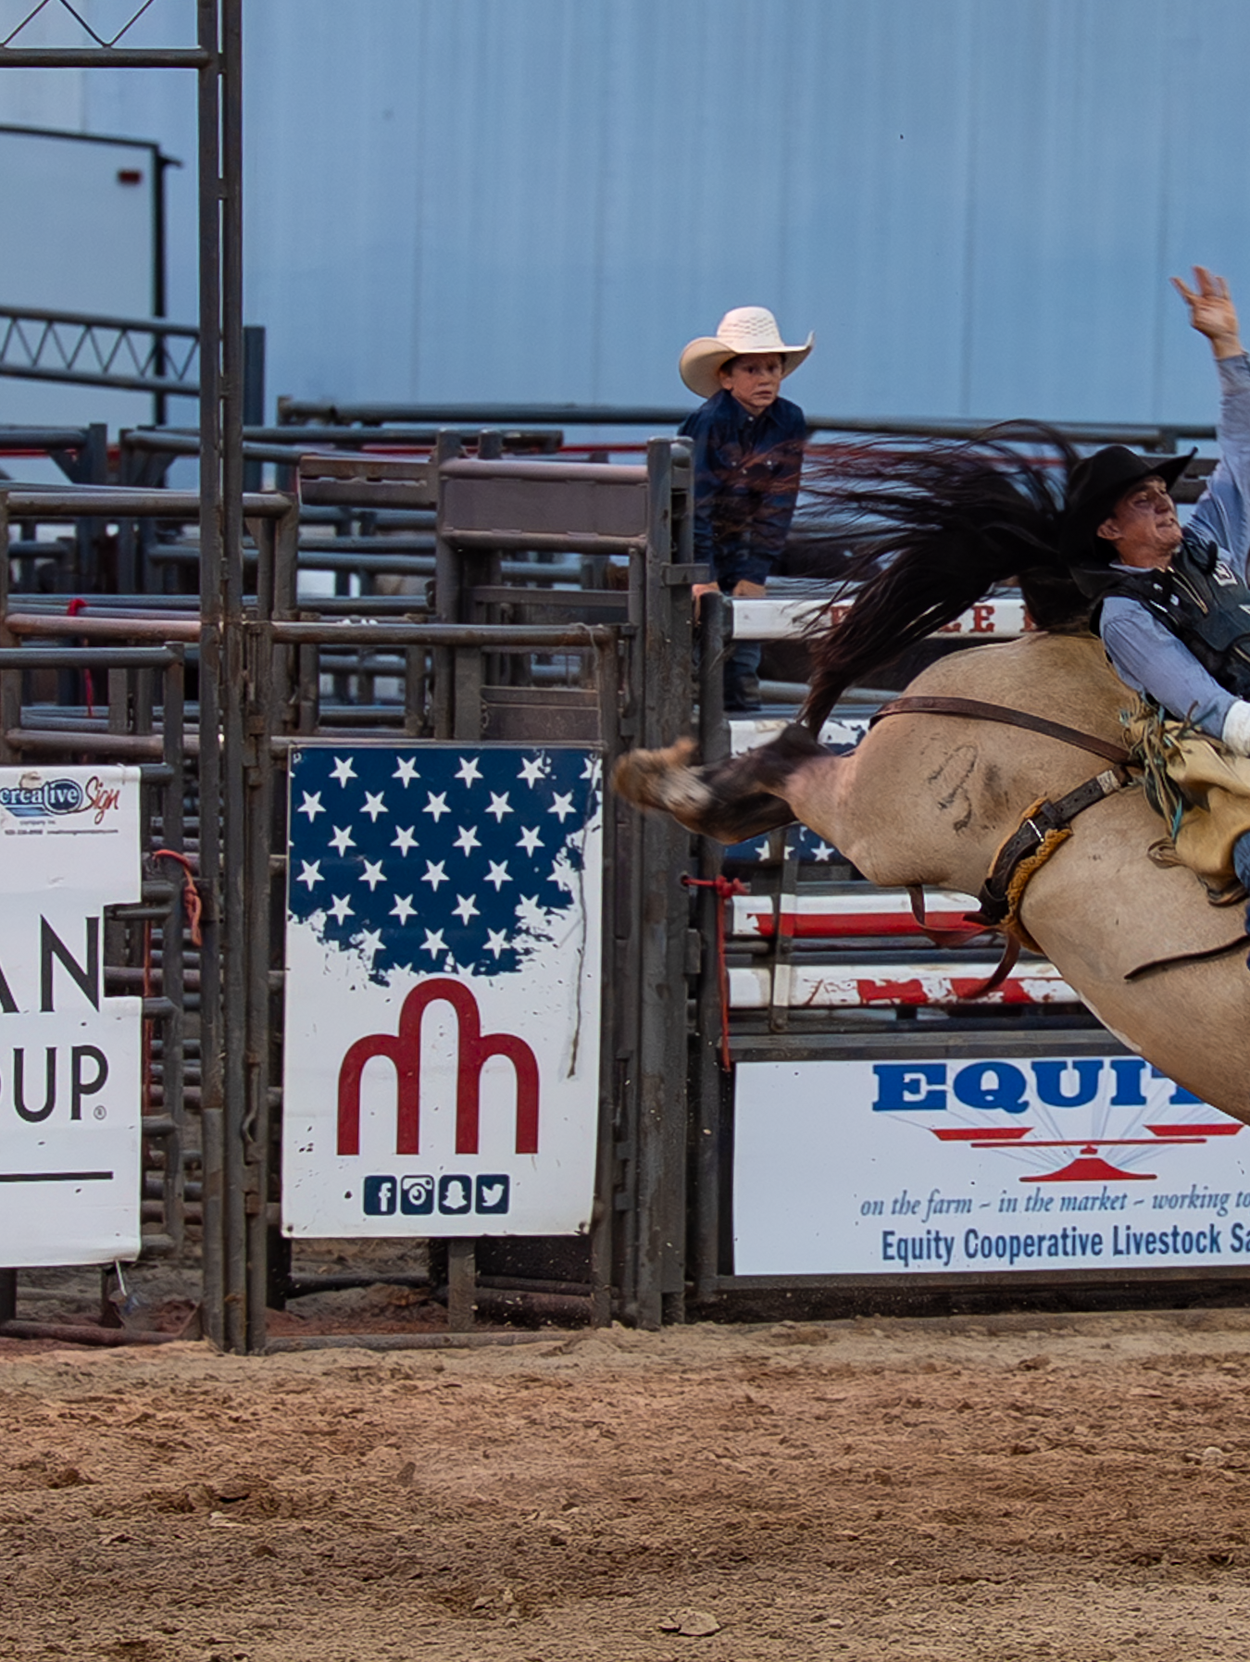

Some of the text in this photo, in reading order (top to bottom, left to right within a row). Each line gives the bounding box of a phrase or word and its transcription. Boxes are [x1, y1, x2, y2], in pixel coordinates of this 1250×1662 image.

[85, 776, 120, 825] Sign
[0, 914, 101, 1013] N
[0, 1044, 109, 1123] UP
[872, 1059, 1204, 1114] EQUI
[860, 1200, 884, 1216] on
[891, 1189, 922, 1215] the
[921, 1188, 973, 1223] farm
[998, 1190, 1018, 1213] in
[1025, 1186, 1054, 1213] the
[1060, 1185, 1128, 1212] market
[1152, 1184, 1231, 1217] working
[882, 1229, 955, 1267] Equity
[964, 1225, 1103, 1265] Cooperative
[1112, 1223, 1222, 1257] Livestock
